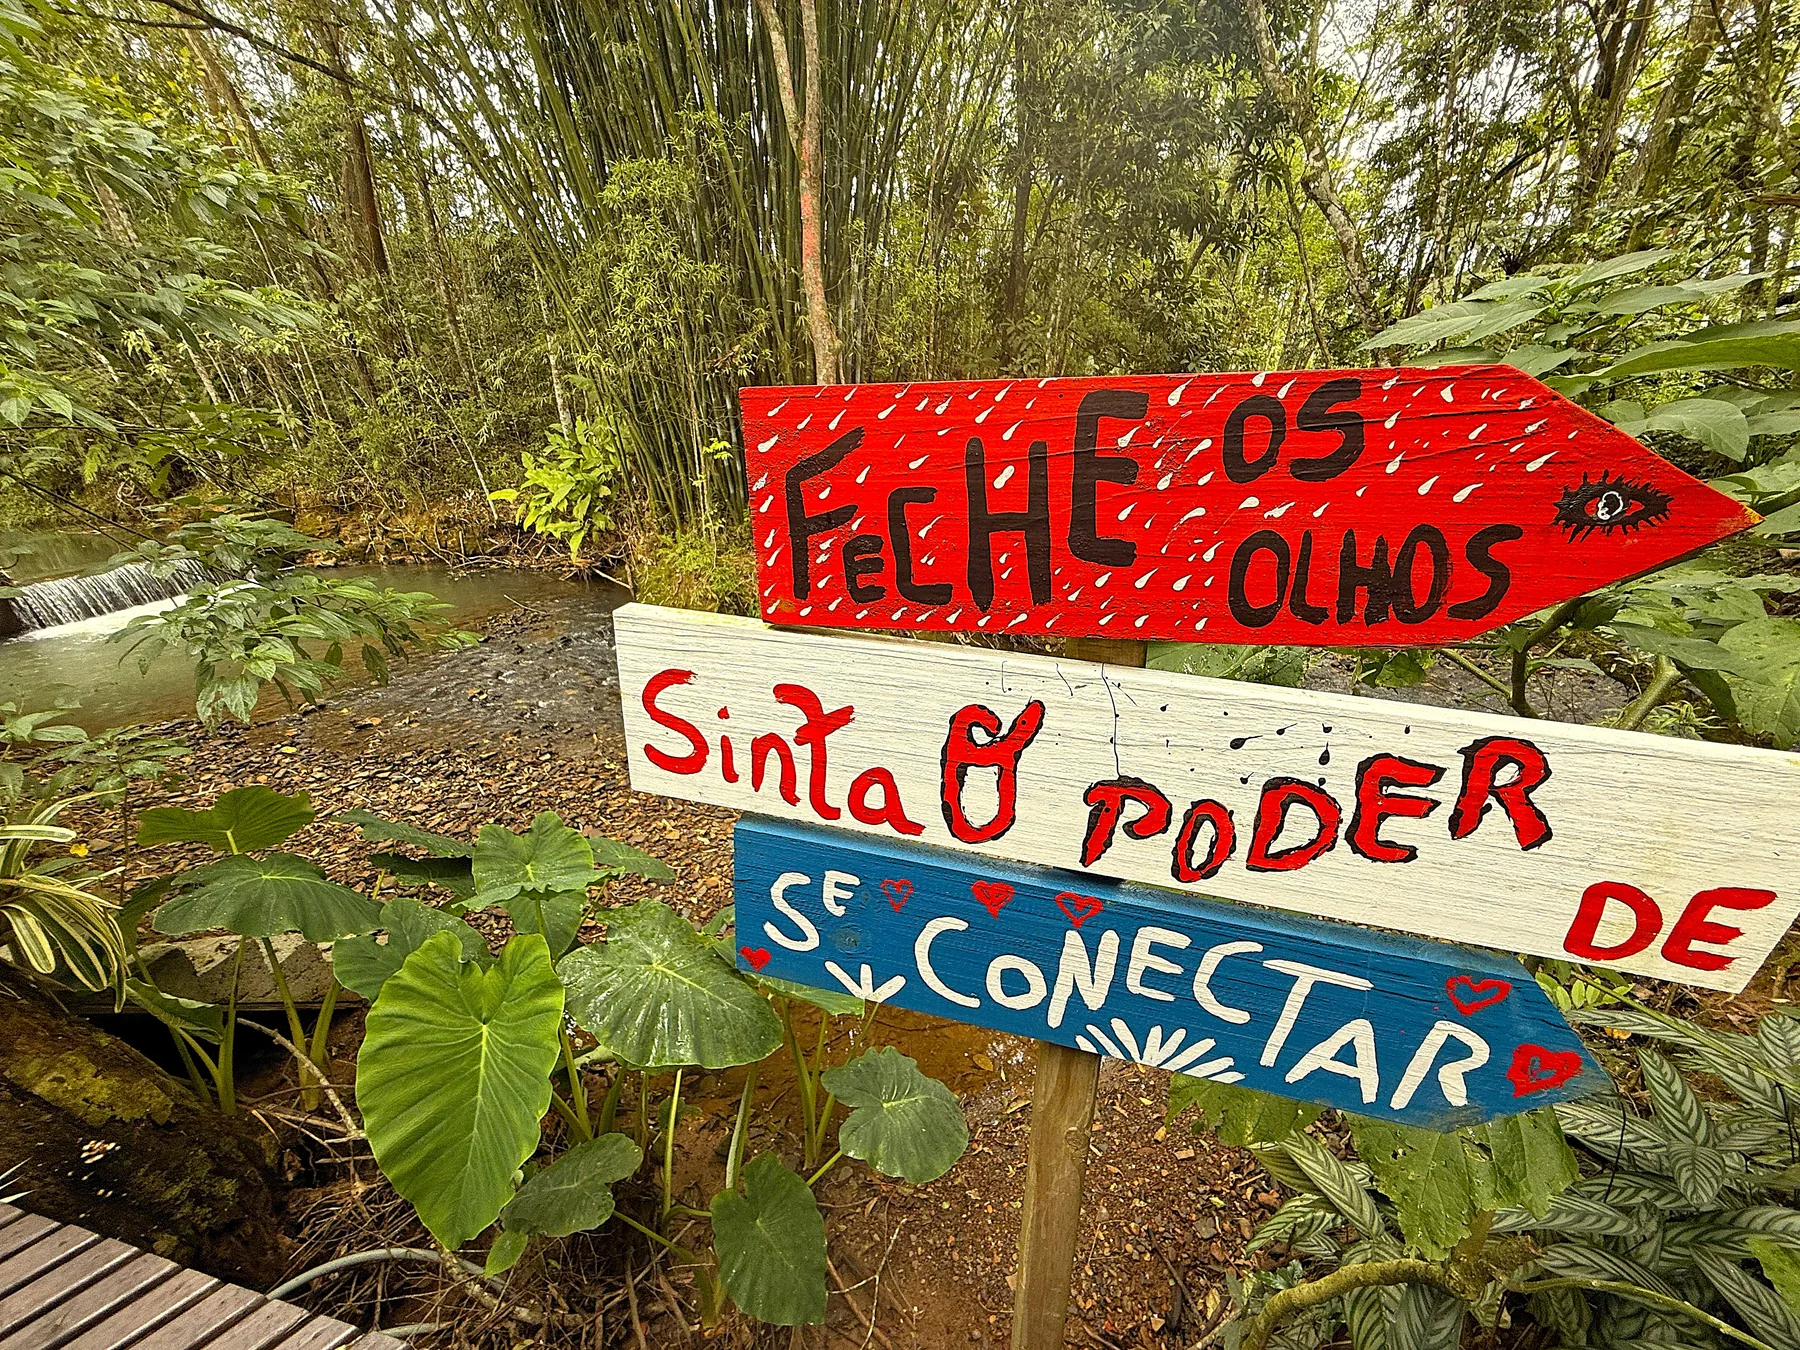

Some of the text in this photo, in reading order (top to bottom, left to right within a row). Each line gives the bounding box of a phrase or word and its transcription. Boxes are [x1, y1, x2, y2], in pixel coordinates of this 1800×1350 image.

[1222, 378, 1365, 484] OS
[1228, 523, 1524, 628] OLHOS
[642, 668, 926, 836] Sinta
[1079, 735, 1553, 883] PODER
[1563, 881, 1778, 972] DE
[762, 870, 1492, 1111] SE CONECTAR
